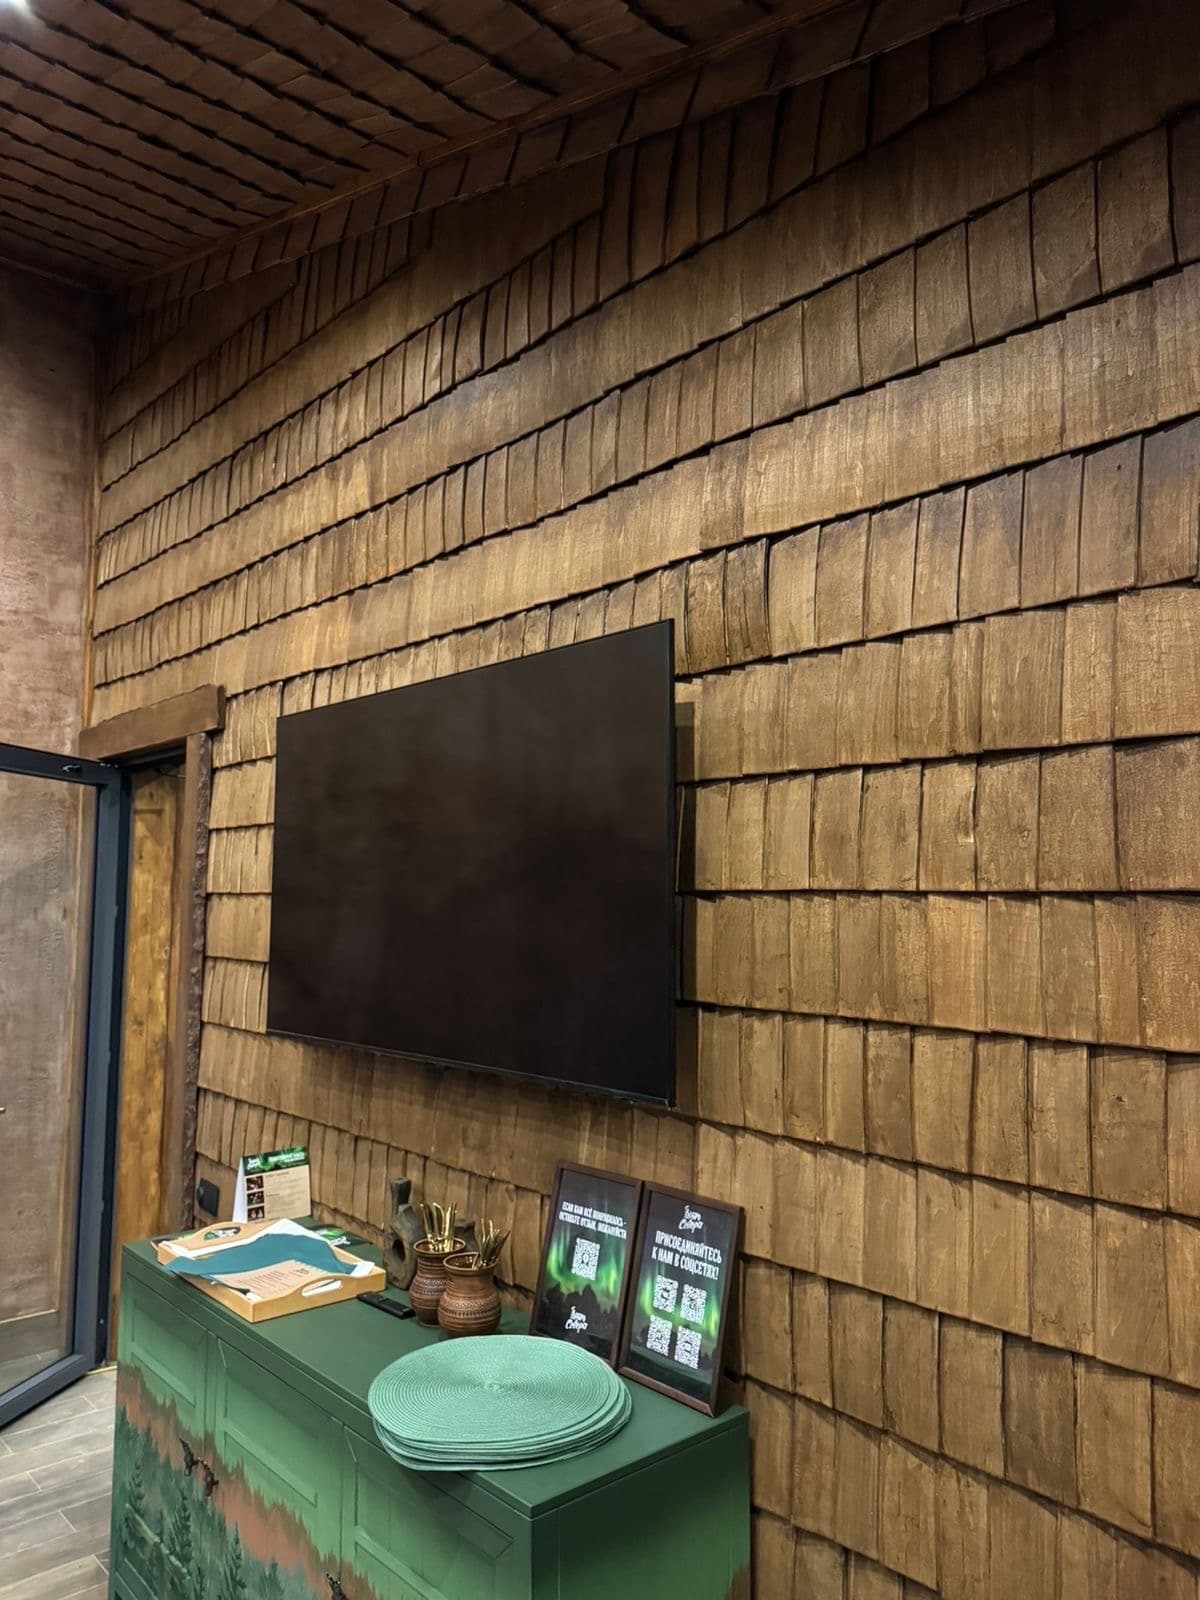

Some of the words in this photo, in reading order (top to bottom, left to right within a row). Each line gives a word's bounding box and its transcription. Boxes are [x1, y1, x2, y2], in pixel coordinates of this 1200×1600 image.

[651, 1246, 659, 1260] К
[658, 1247, 674, 1266] НАМ
[674, 1253, 681, 1268] В
[680, 1255, 720, 1281] СОЦСЕТЯХ!
[655, 1230, 722, 1264] ПРИСОЕДИНЯЙТЕСЬ
